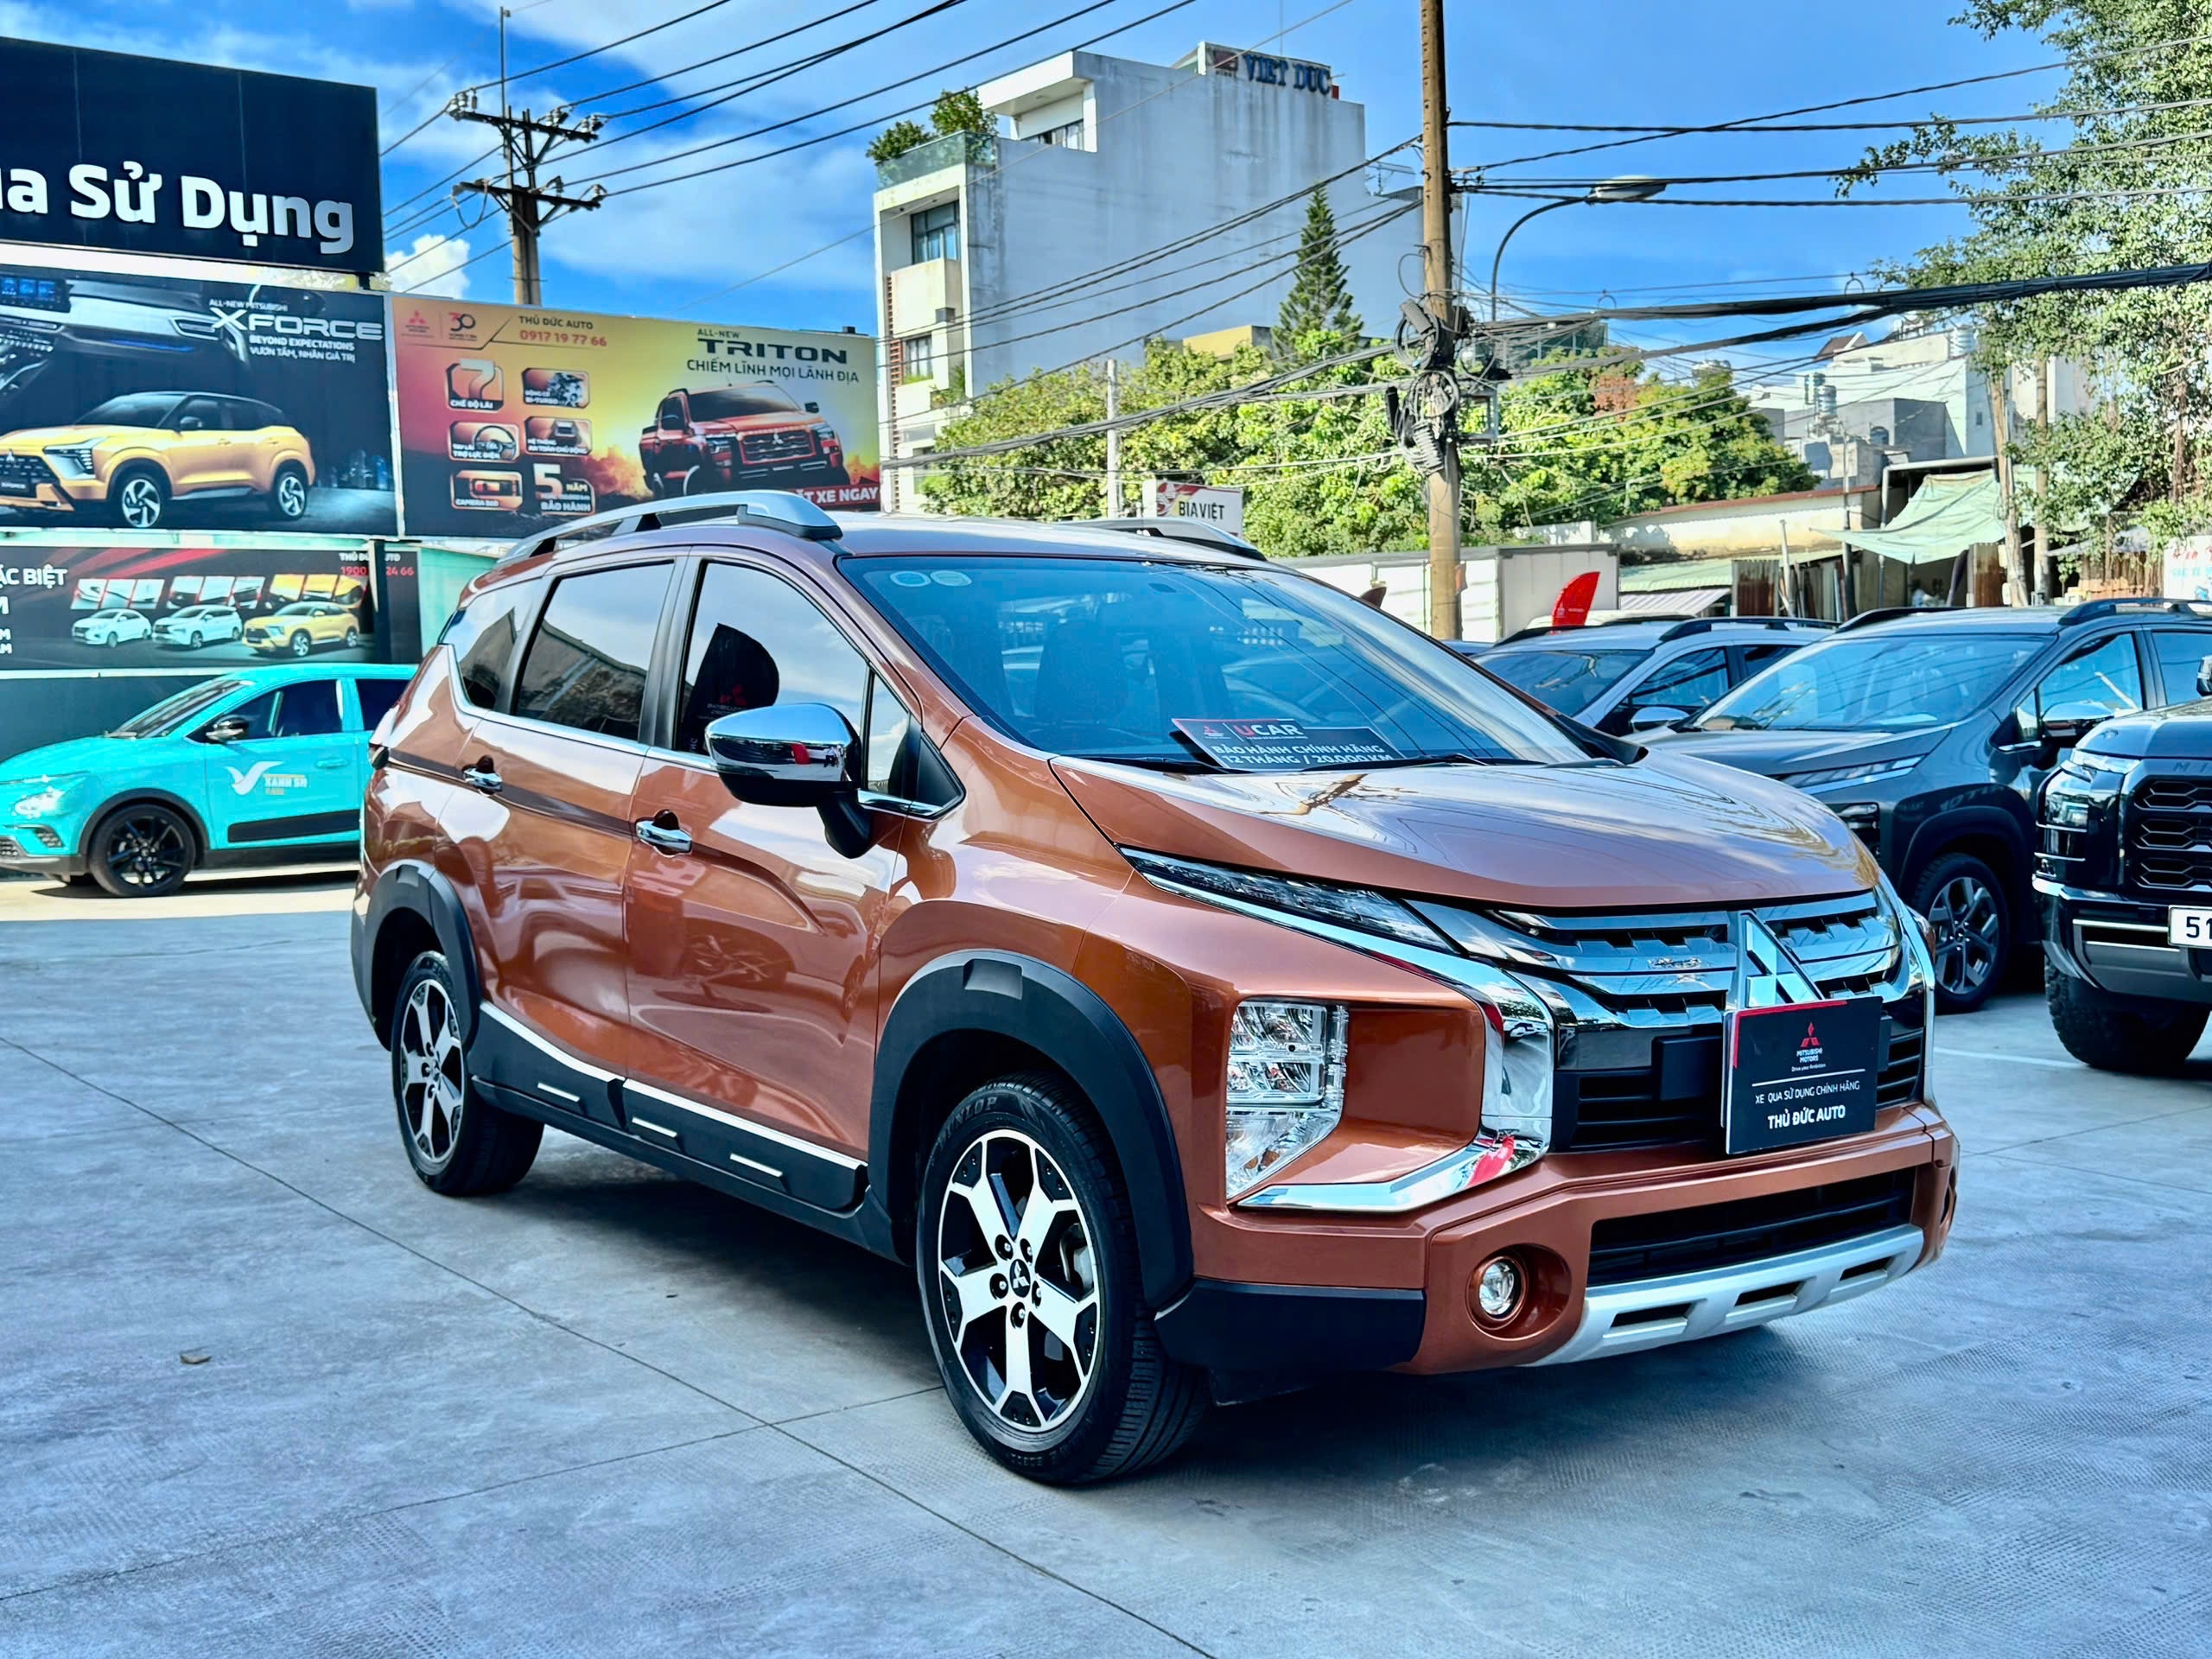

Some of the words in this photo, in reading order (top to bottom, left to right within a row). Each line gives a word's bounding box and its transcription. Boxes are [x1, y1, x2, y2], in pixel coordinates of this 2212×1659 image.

[0, 168, 48, 214] a
[68, 161, 162, 224] Sử
[181, 175, 354, 254] Dụng
[210, 307, 383, 340] XFORCE
[518, 313, 540, 326] THỦ
[566, 320, 594, 330] AUTO
[249, 334, 288, 346] BEYOND
[289, 337, 355, 351] EXPECTATIONS
[520, 330, 550, 342] 0917
[555, 332, 568, 343] 19
[573, 334, 588, 345] 77
[590, 334, 607, 346] 66
[697, 327, 740, 339] ALL-NEW
[697, 338, 847, 365] TRITON
[687, 357, 732, 373] CHIẾM
[734, 360, 766, 377] LĨNH
[770, 365, 795, 381] MỌI
[798, 366, 834, 382] LÃNH
[837, 371, 859, 385] ĐỊA
[533, 463, 563, 499] 5
[817, 490, 836, 504] XE
[839, 486, 879, 502] NGAY
[23, 563, 68, 589] BIỆT
[1232, 724, 1304, 736] UCAR
[1211, 744, 1246, 754] BẢO
[1244, 745, 1292, 754] HÀNH
[1292, 744, 1342, 753] CHÍNH
[1339, 744, 1385, 753] HÃNG
[1221, 755, 1244, 764] 12
[1241, 753, 1301, 764] THÁNG
[1755, 1094, 1764, 1104] XE
[1768, 1092, 1783, 1103] QUA
[1795, 1087, 1815, 1100] DỤNG
[1840, 1080, 1860, 1091] HÃNG
[1768, 1108, 1790, 1129] THỦ
[1792, 1107, 1815, 1126] ĐỨC
[1816, 1104, 1846, 1122] AUTO
